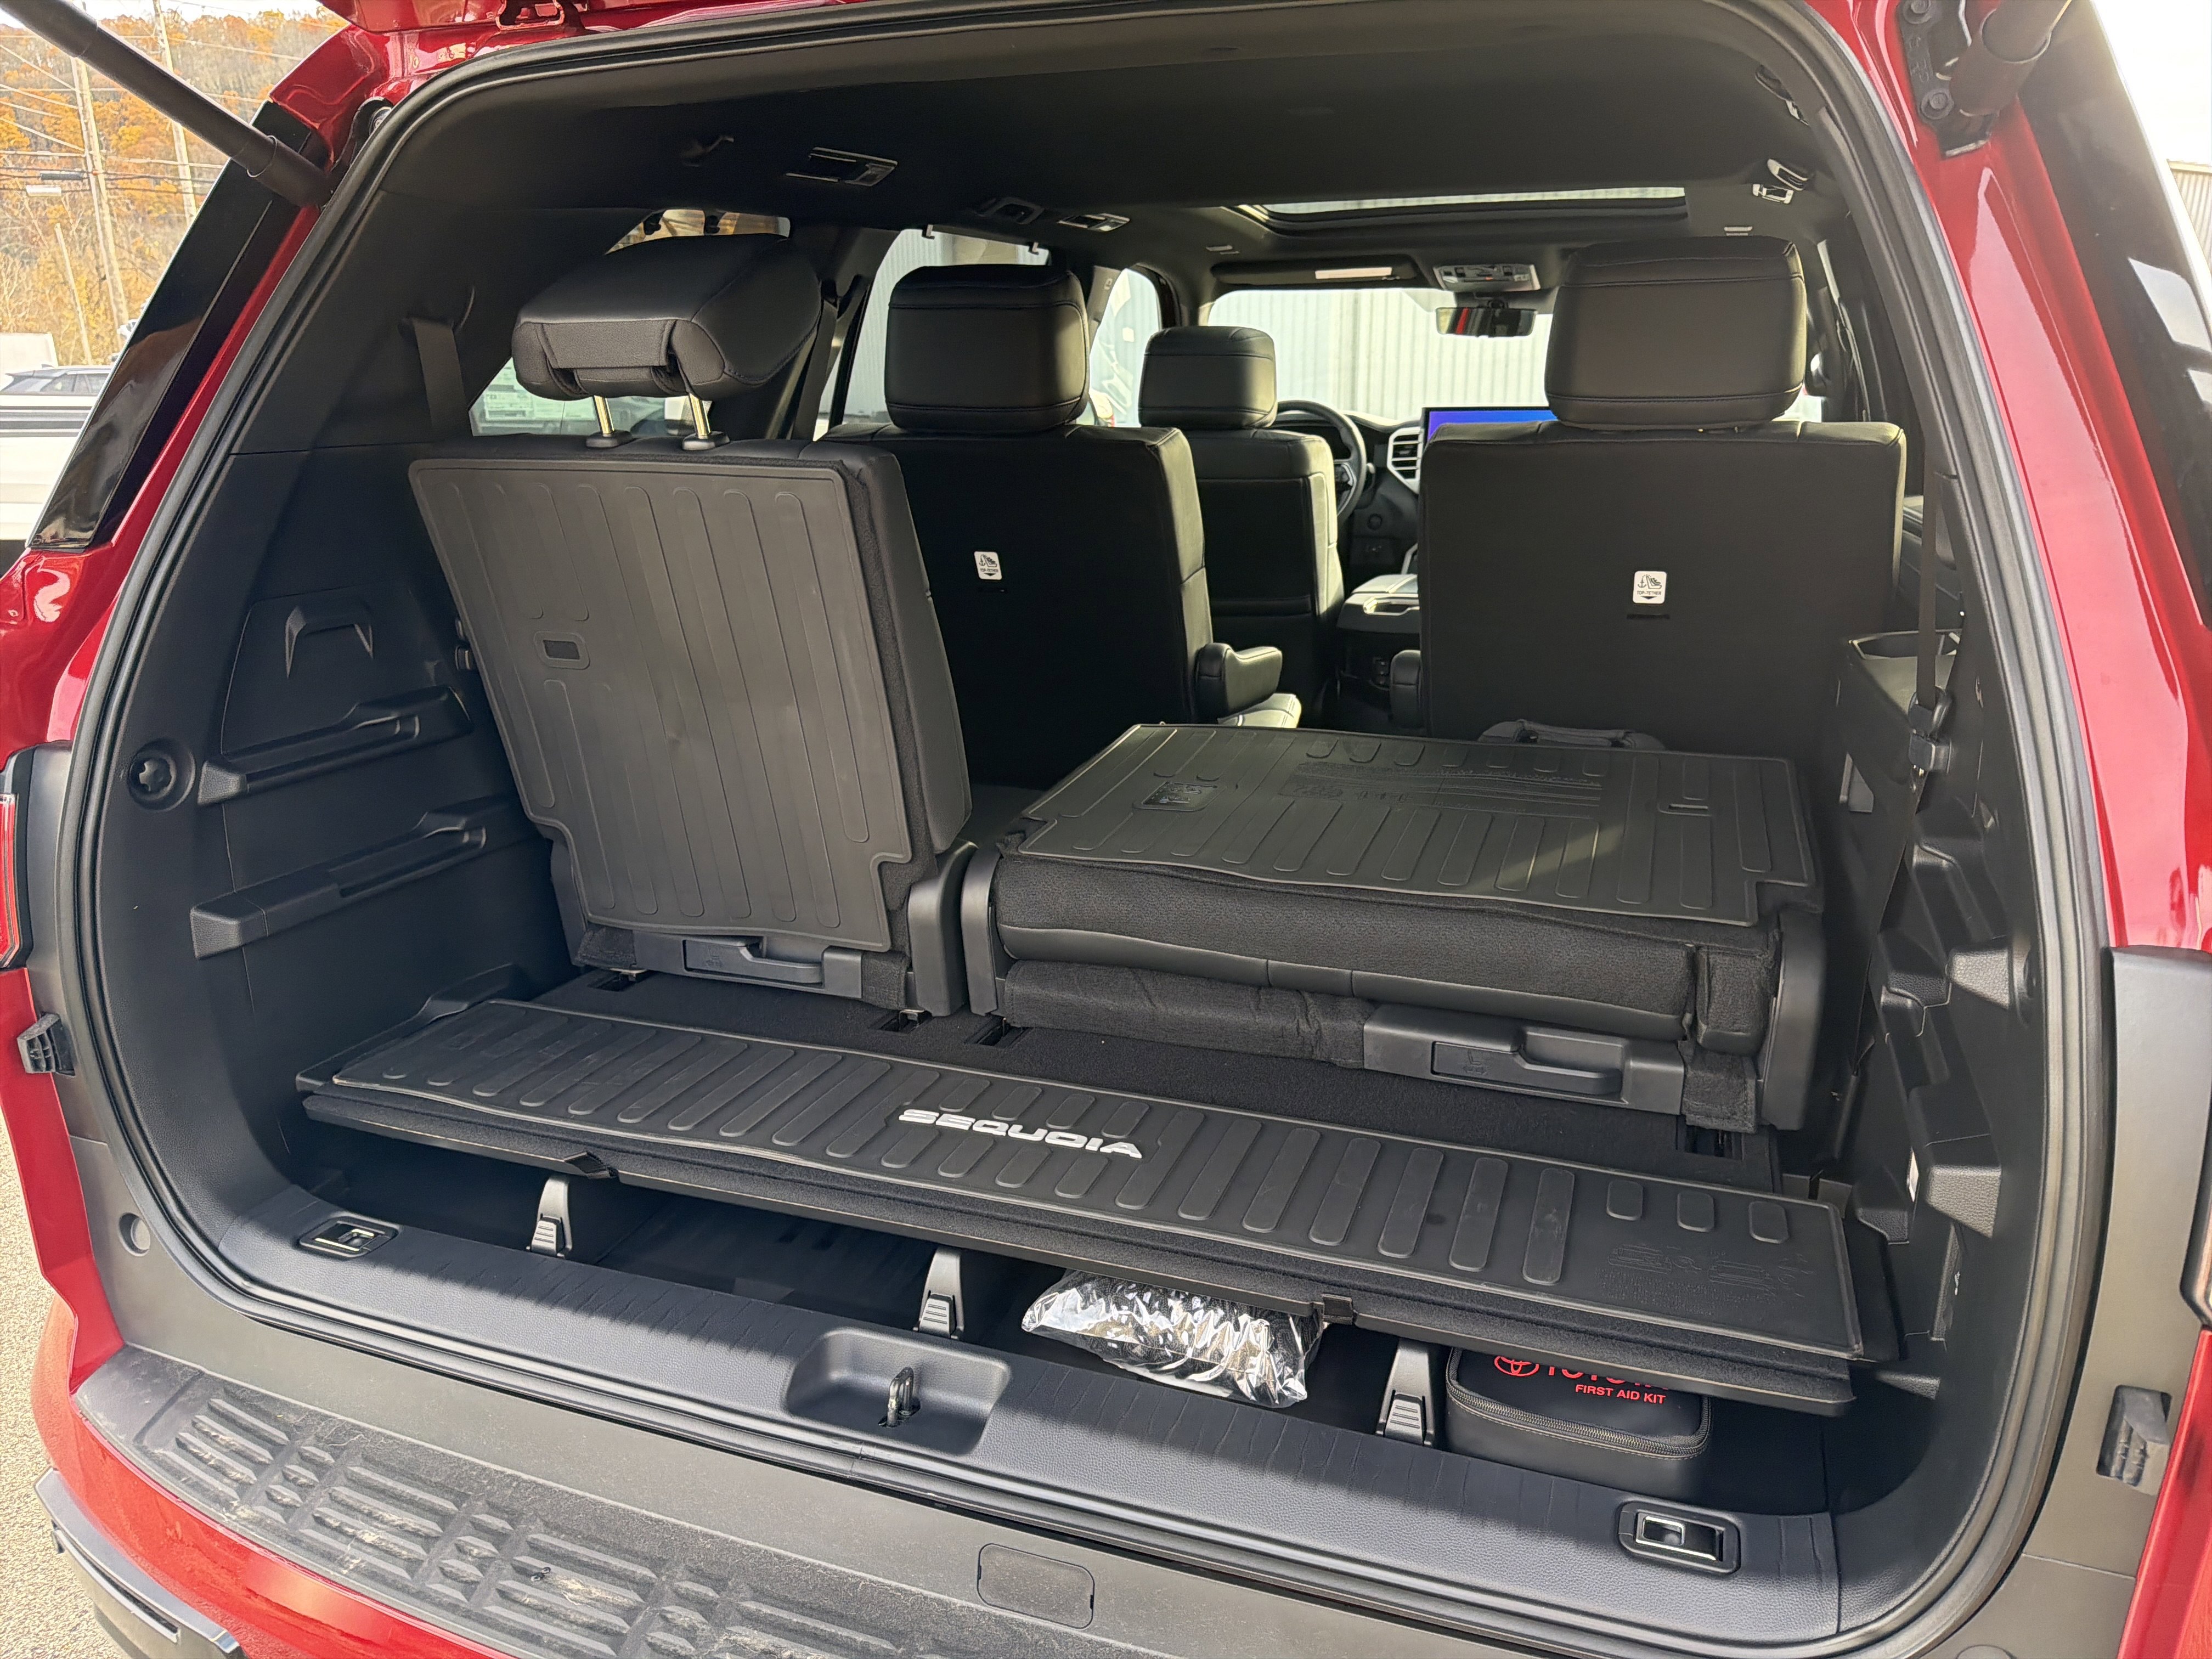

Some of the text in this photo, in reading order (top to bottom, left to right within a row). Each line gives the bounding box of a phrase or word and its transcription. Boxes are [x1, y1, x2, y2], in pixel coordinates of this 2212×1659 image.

[899, 1109, 1142, 1159] SEQUOIA
[1575, 1384, 1666, 1404] FIRST AID KIT
